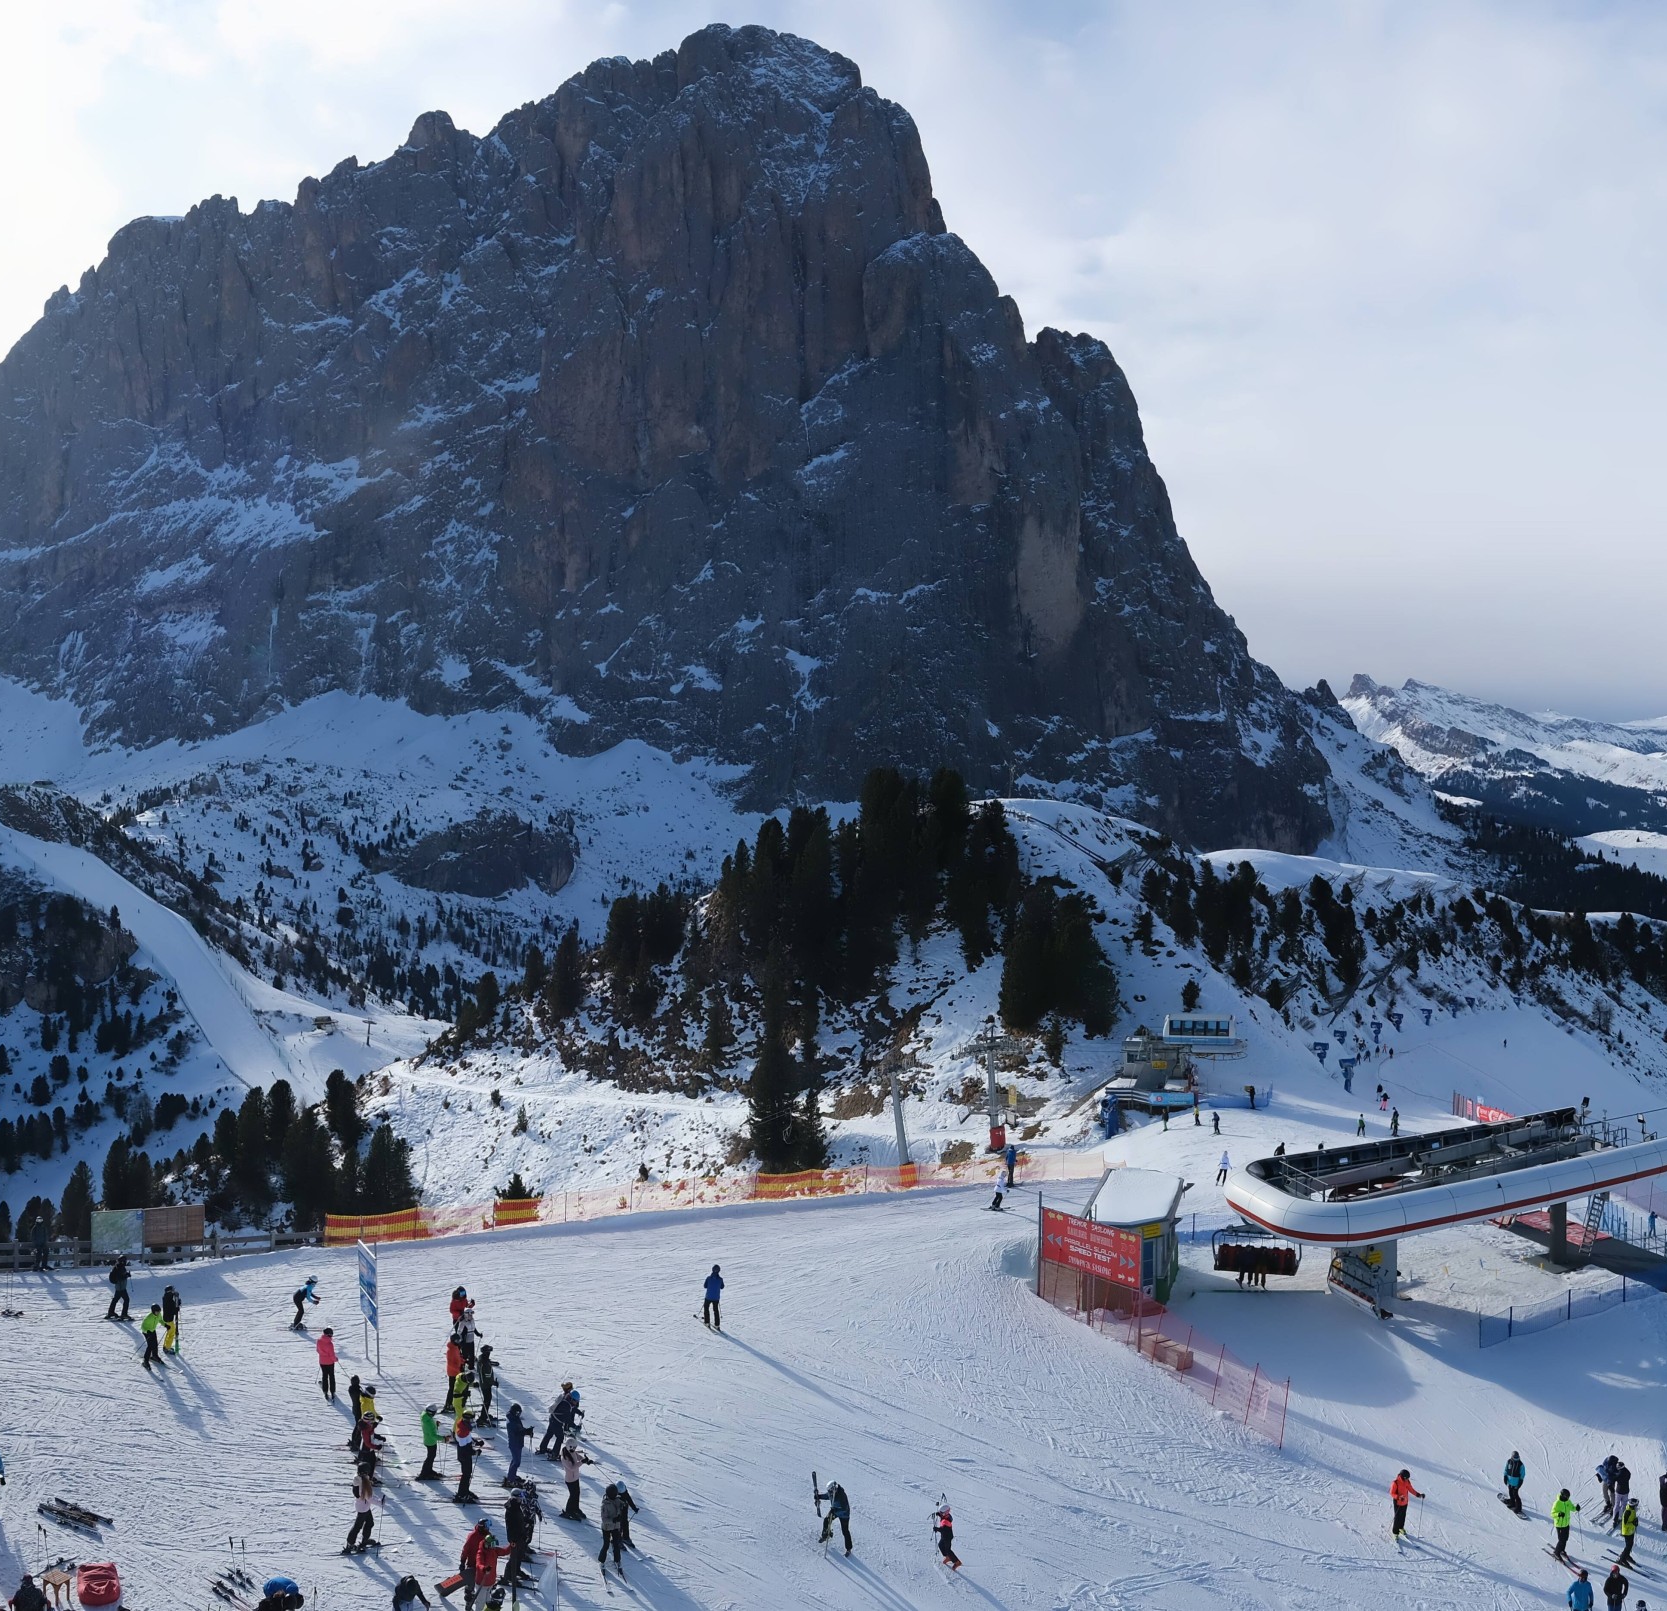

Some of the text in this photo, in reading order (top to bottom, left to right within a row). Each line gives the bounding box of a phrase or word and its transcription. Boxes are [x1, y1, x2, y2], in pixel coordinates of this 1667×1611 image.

[1064, 1237, 1118, 1258] PARALLEL SLALOM
[1070, 1245, 1111, 1263] SPEED TEST
